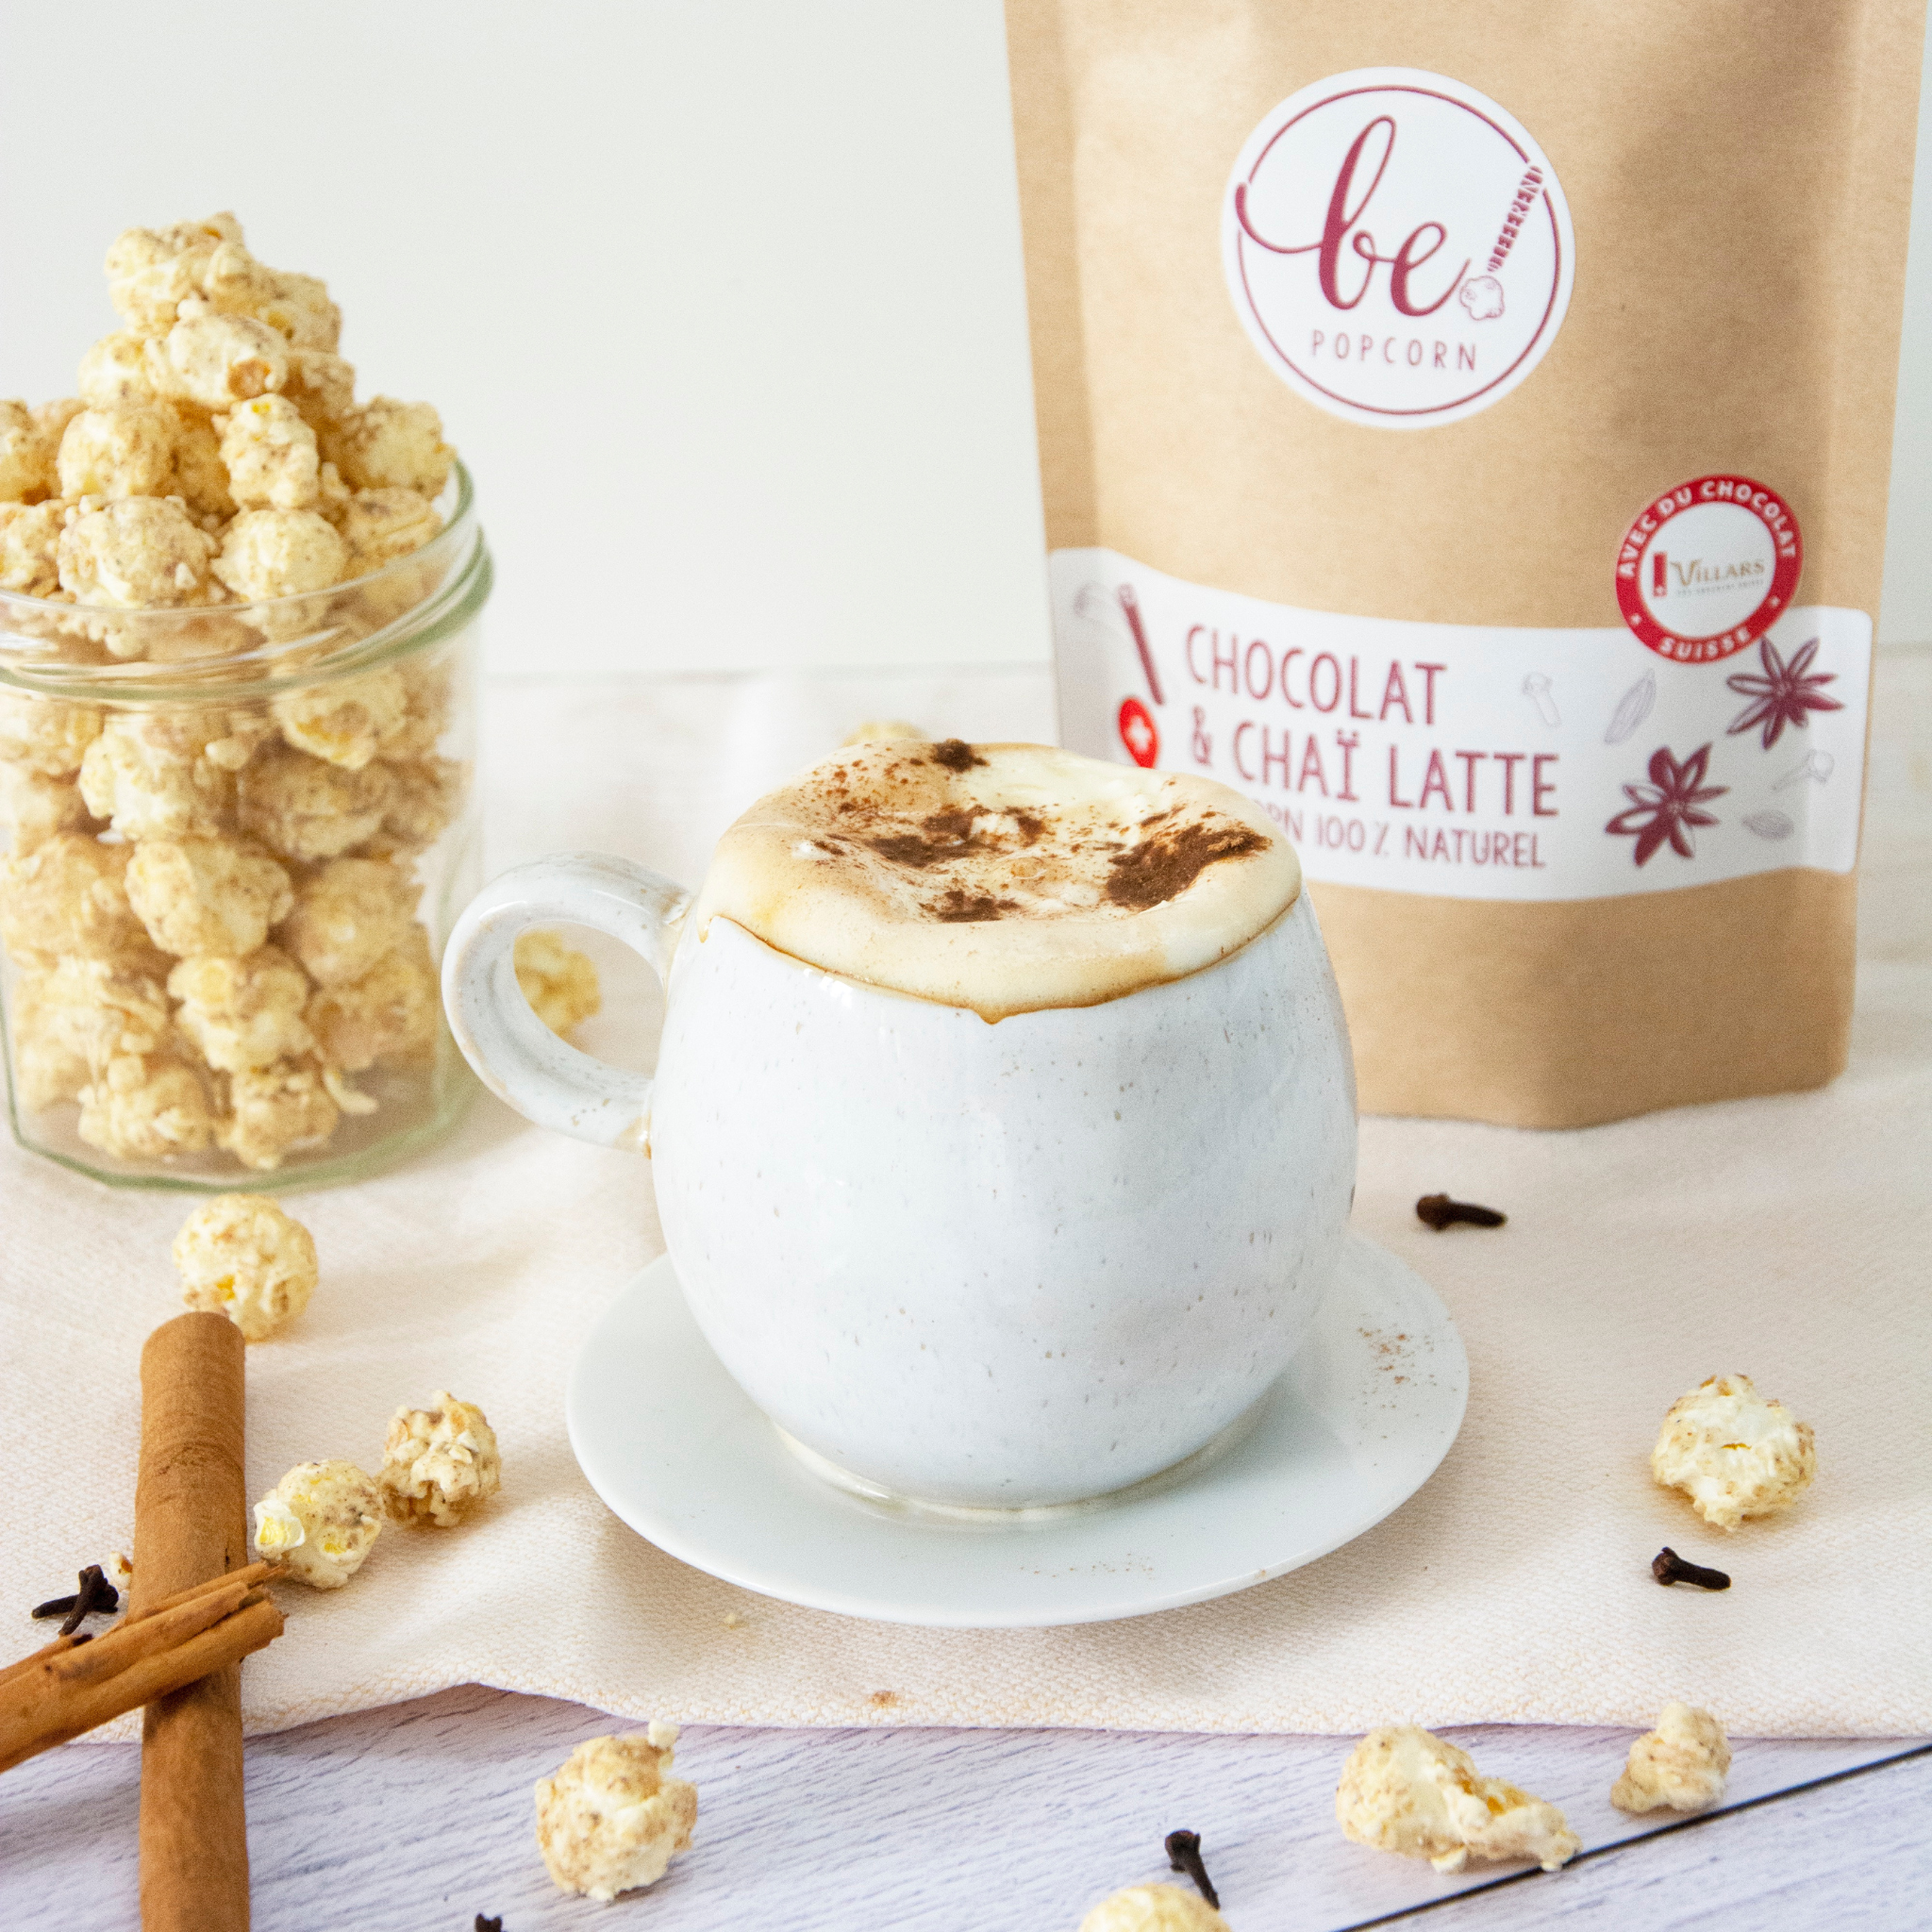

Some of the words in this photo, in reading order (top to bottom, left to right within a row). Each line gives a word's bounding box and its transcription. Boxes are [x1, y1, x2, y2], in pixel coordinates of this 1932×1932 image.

[1312, 328, 1476, 371] POPCORN
[1619, 515, 1657, 577] AVEC
[1657, 487, 1692, 516] DU
[1700, 480, 1796, 558] CHOCOLAT
[1185, 624, 1447, 725] CHOCOLAT
[1659, 625, 1751, 658] SUISSE
[1191, 705, 1211, 767] &
[1233, 720, 1360, 802] CHAÏ
[1389, 744, 1559, 818] LATTE
[1405, 824, 1546, 869] NATUREL
